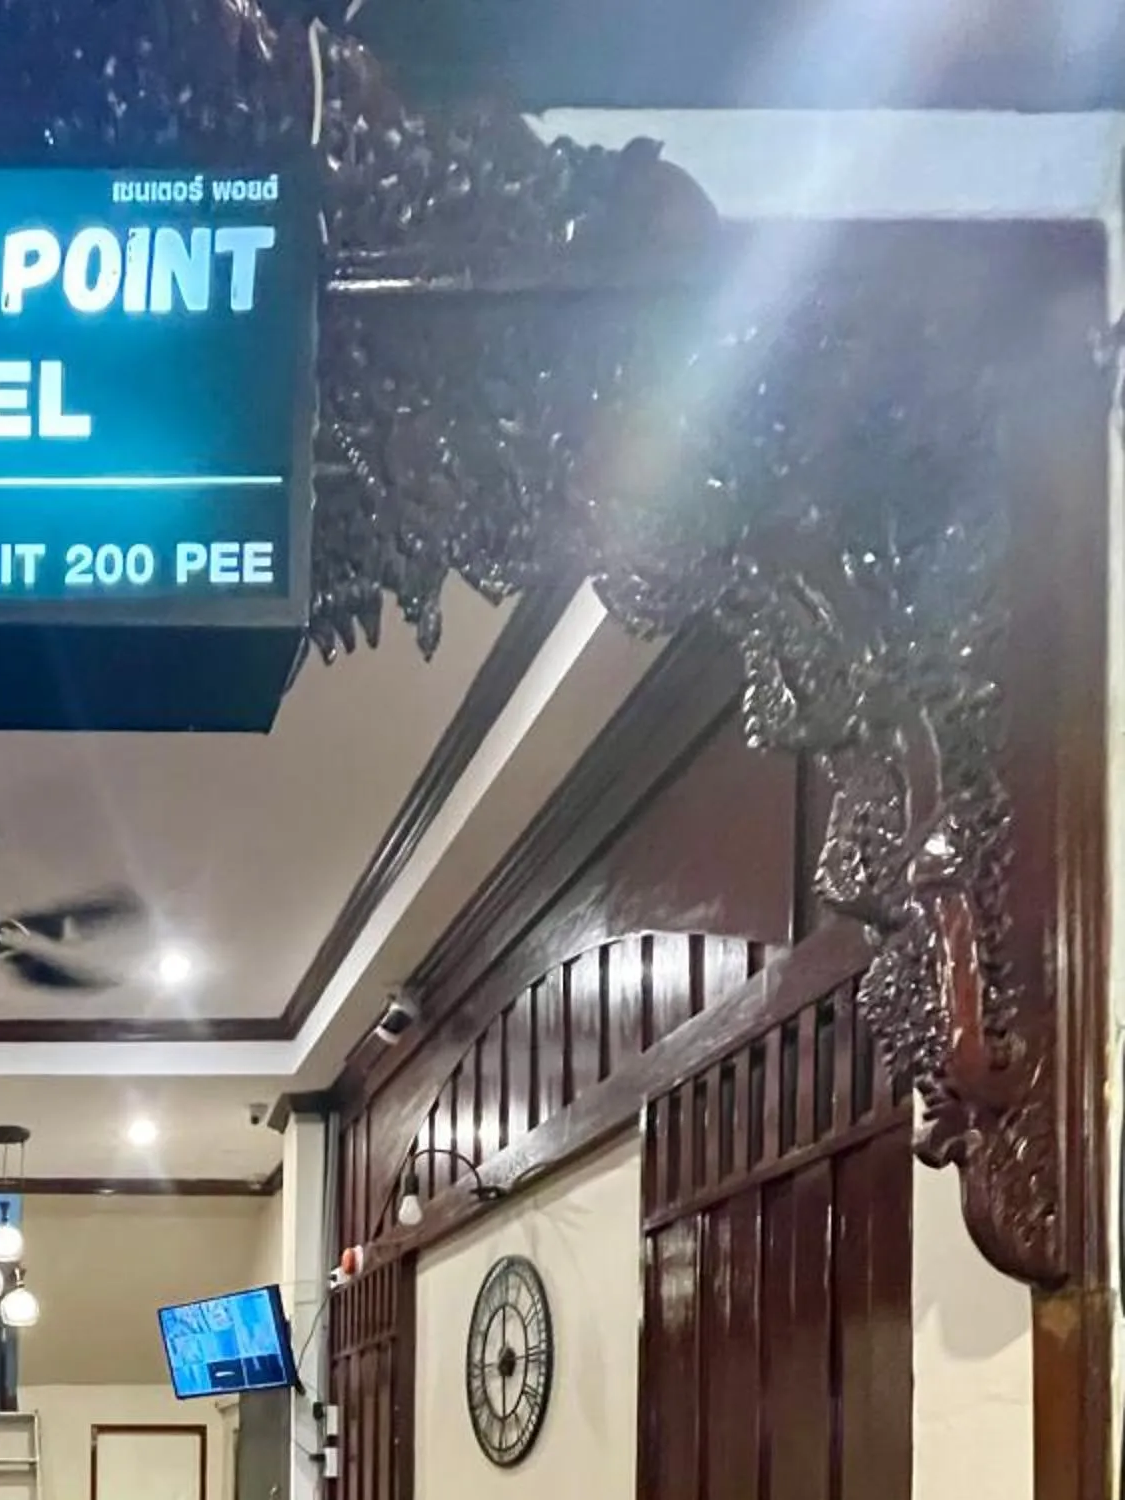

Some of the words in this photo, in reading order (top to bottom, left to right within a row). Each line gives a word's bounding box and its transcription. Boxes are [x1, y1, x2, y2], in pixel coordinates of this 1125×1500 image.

[0, 226, 275, 314] POINT
[65, 543, 154, 585] 200
[176, 541, 273, 584] PEE
